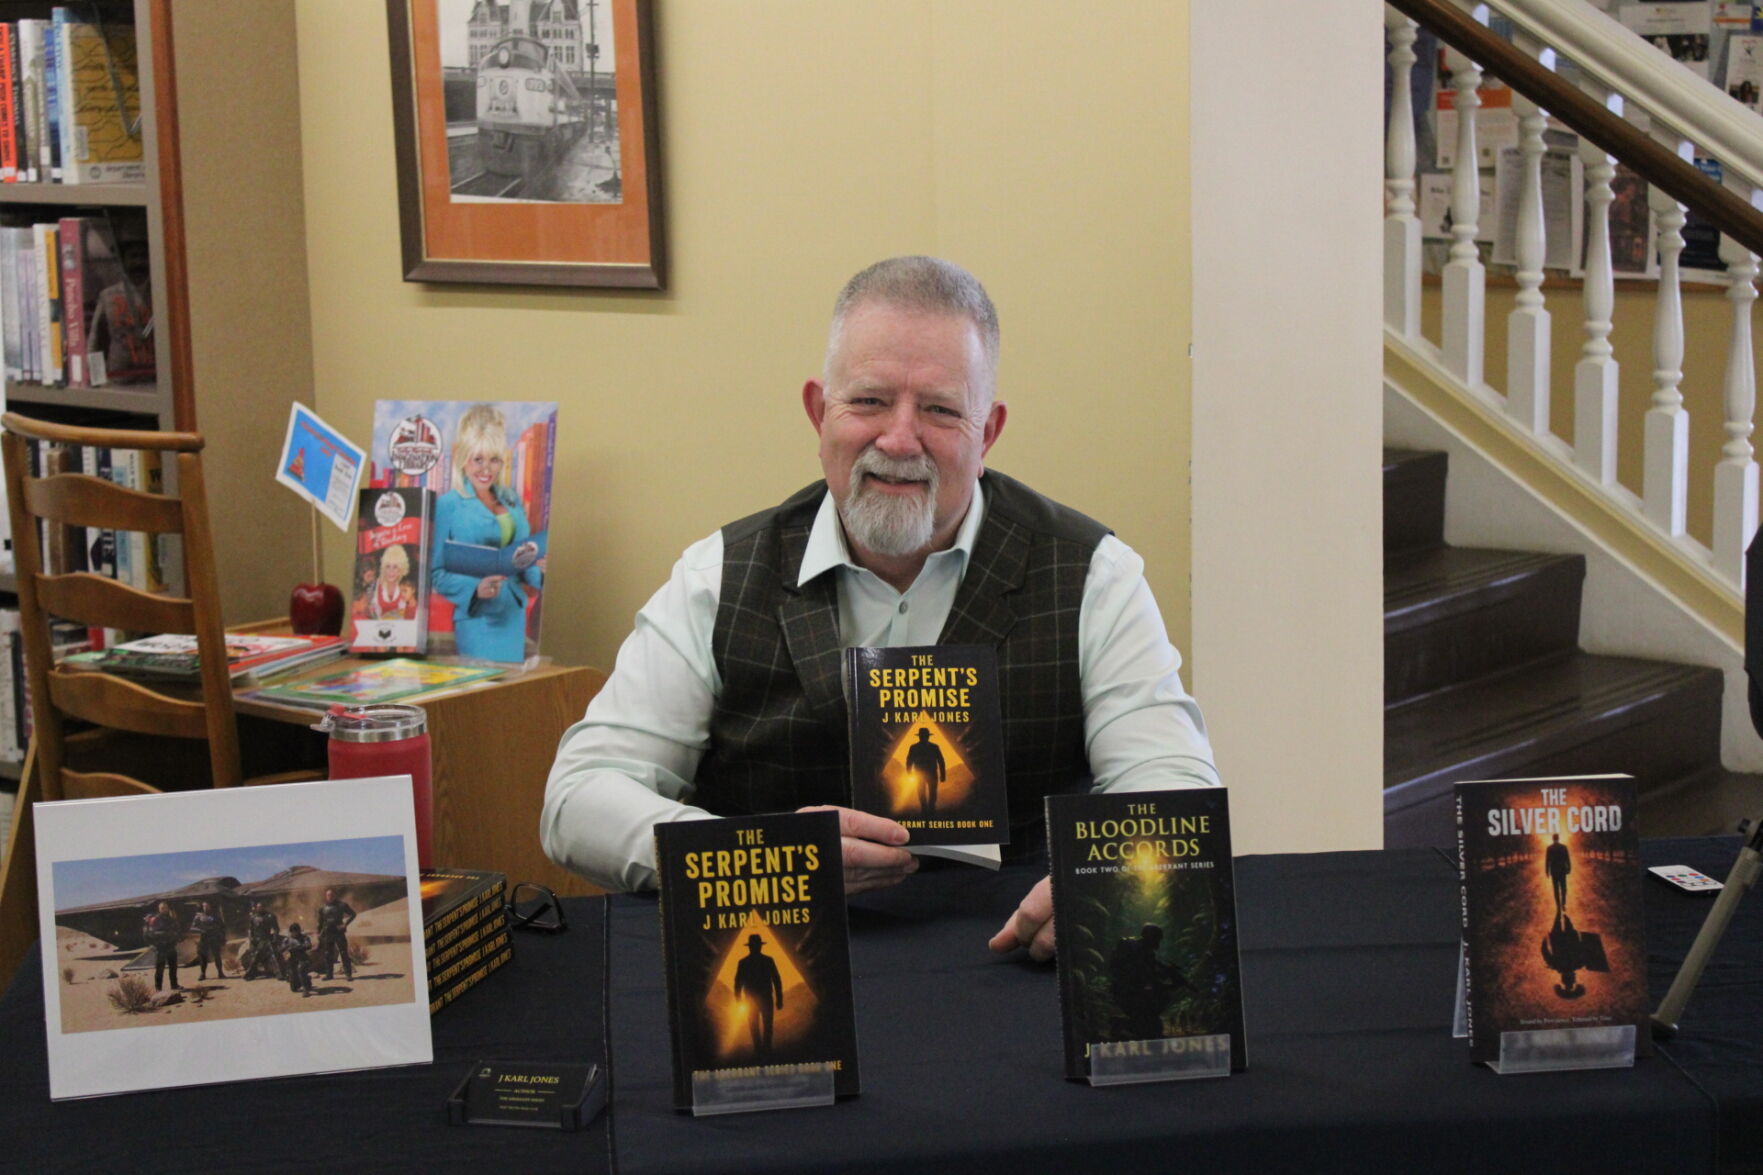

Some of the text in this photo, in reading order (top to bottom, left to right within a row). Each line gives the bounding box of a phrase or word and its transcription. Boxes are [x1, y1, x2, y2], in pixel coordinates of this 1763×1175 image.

[65, 278, 76, 319] Pancho
[911, 655, 934, 666] THE
[870, 668, 978, 688] SERPENT'S
[879, 688, 971, 708] PROMISE
[882, 712, 888, 723] J
[932, 712, 970, 722] JONES
[1540, 788, 1567, 806] THE
[1128, 804, 1156, 815] THE
[957, 820, 976, 828] BOOK
[979, 820, 993, 828] ONE
[1075, 816, 1210, 840] BLOODLINE
[1488, 805, 1622, 836] SILVER CORD
[736, 829, 764, 846] THE
[1088, 838, 1200, 861] ACCORDS
[685, 844, 820, 879] SERPENT'S
[1075, 866, 1098, 875] BOOK
[1100, 865, 1119, 874] TWO
[1190, 861, 1214, 870] SERIES
[698, 875, 812, 908] PROMISE
[1460, 886, 1468, 928] CORD
[703, 916, 710, 930] J
[763, 908, 810, 926] JONES
[1084, 1042, 1090, 1058] J
[1101, 1040, 1154, 1058] KARL
[498, 1074, 503, 1084] J
[504, 1074, 528, 1083] KARL
[530, 1076, 560, 1084] JONES
